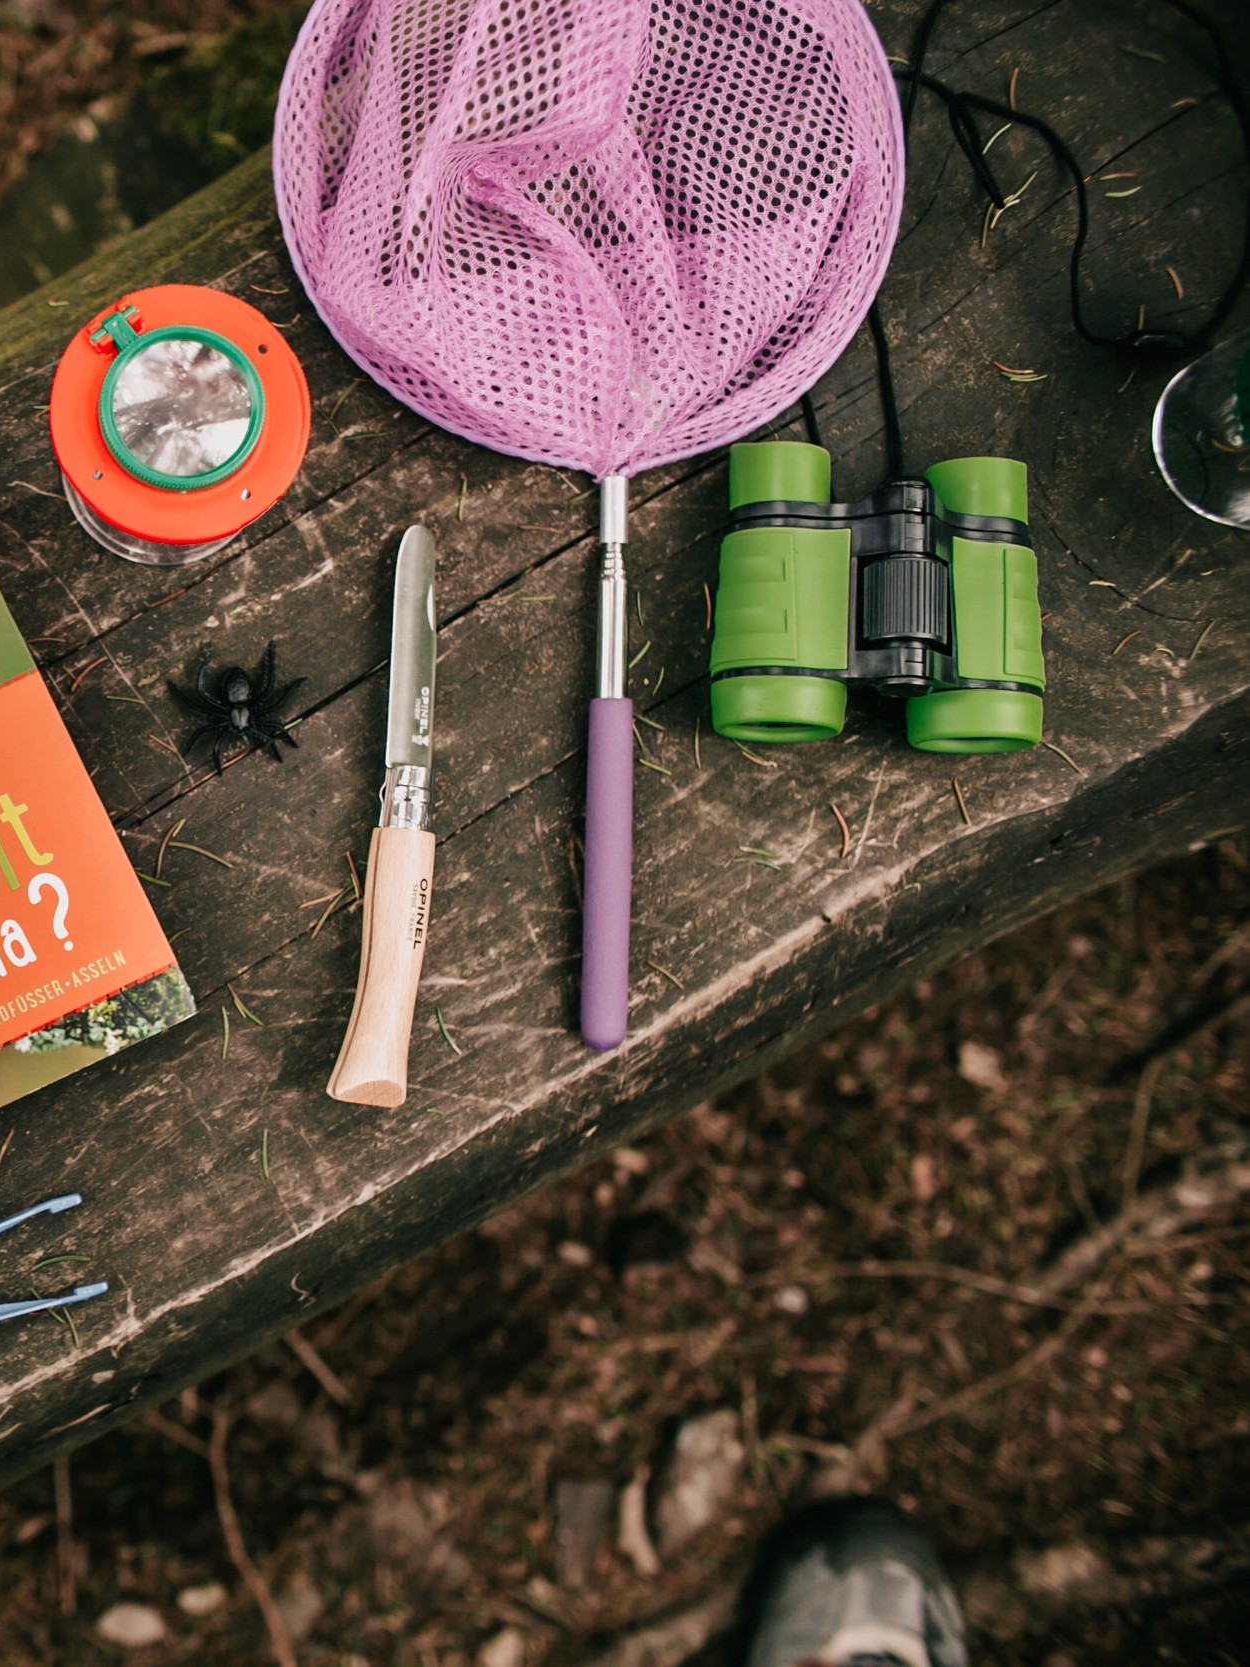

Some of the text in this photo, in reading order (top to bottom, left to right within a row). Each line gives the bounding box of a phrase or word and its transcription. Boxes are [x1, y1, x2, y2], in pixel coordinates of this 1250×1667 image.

[419, 686, 430, 734] OPINEL
[413, 878, 428, 950] OPINEL
[71, 949, 127, 988] ASSELN
